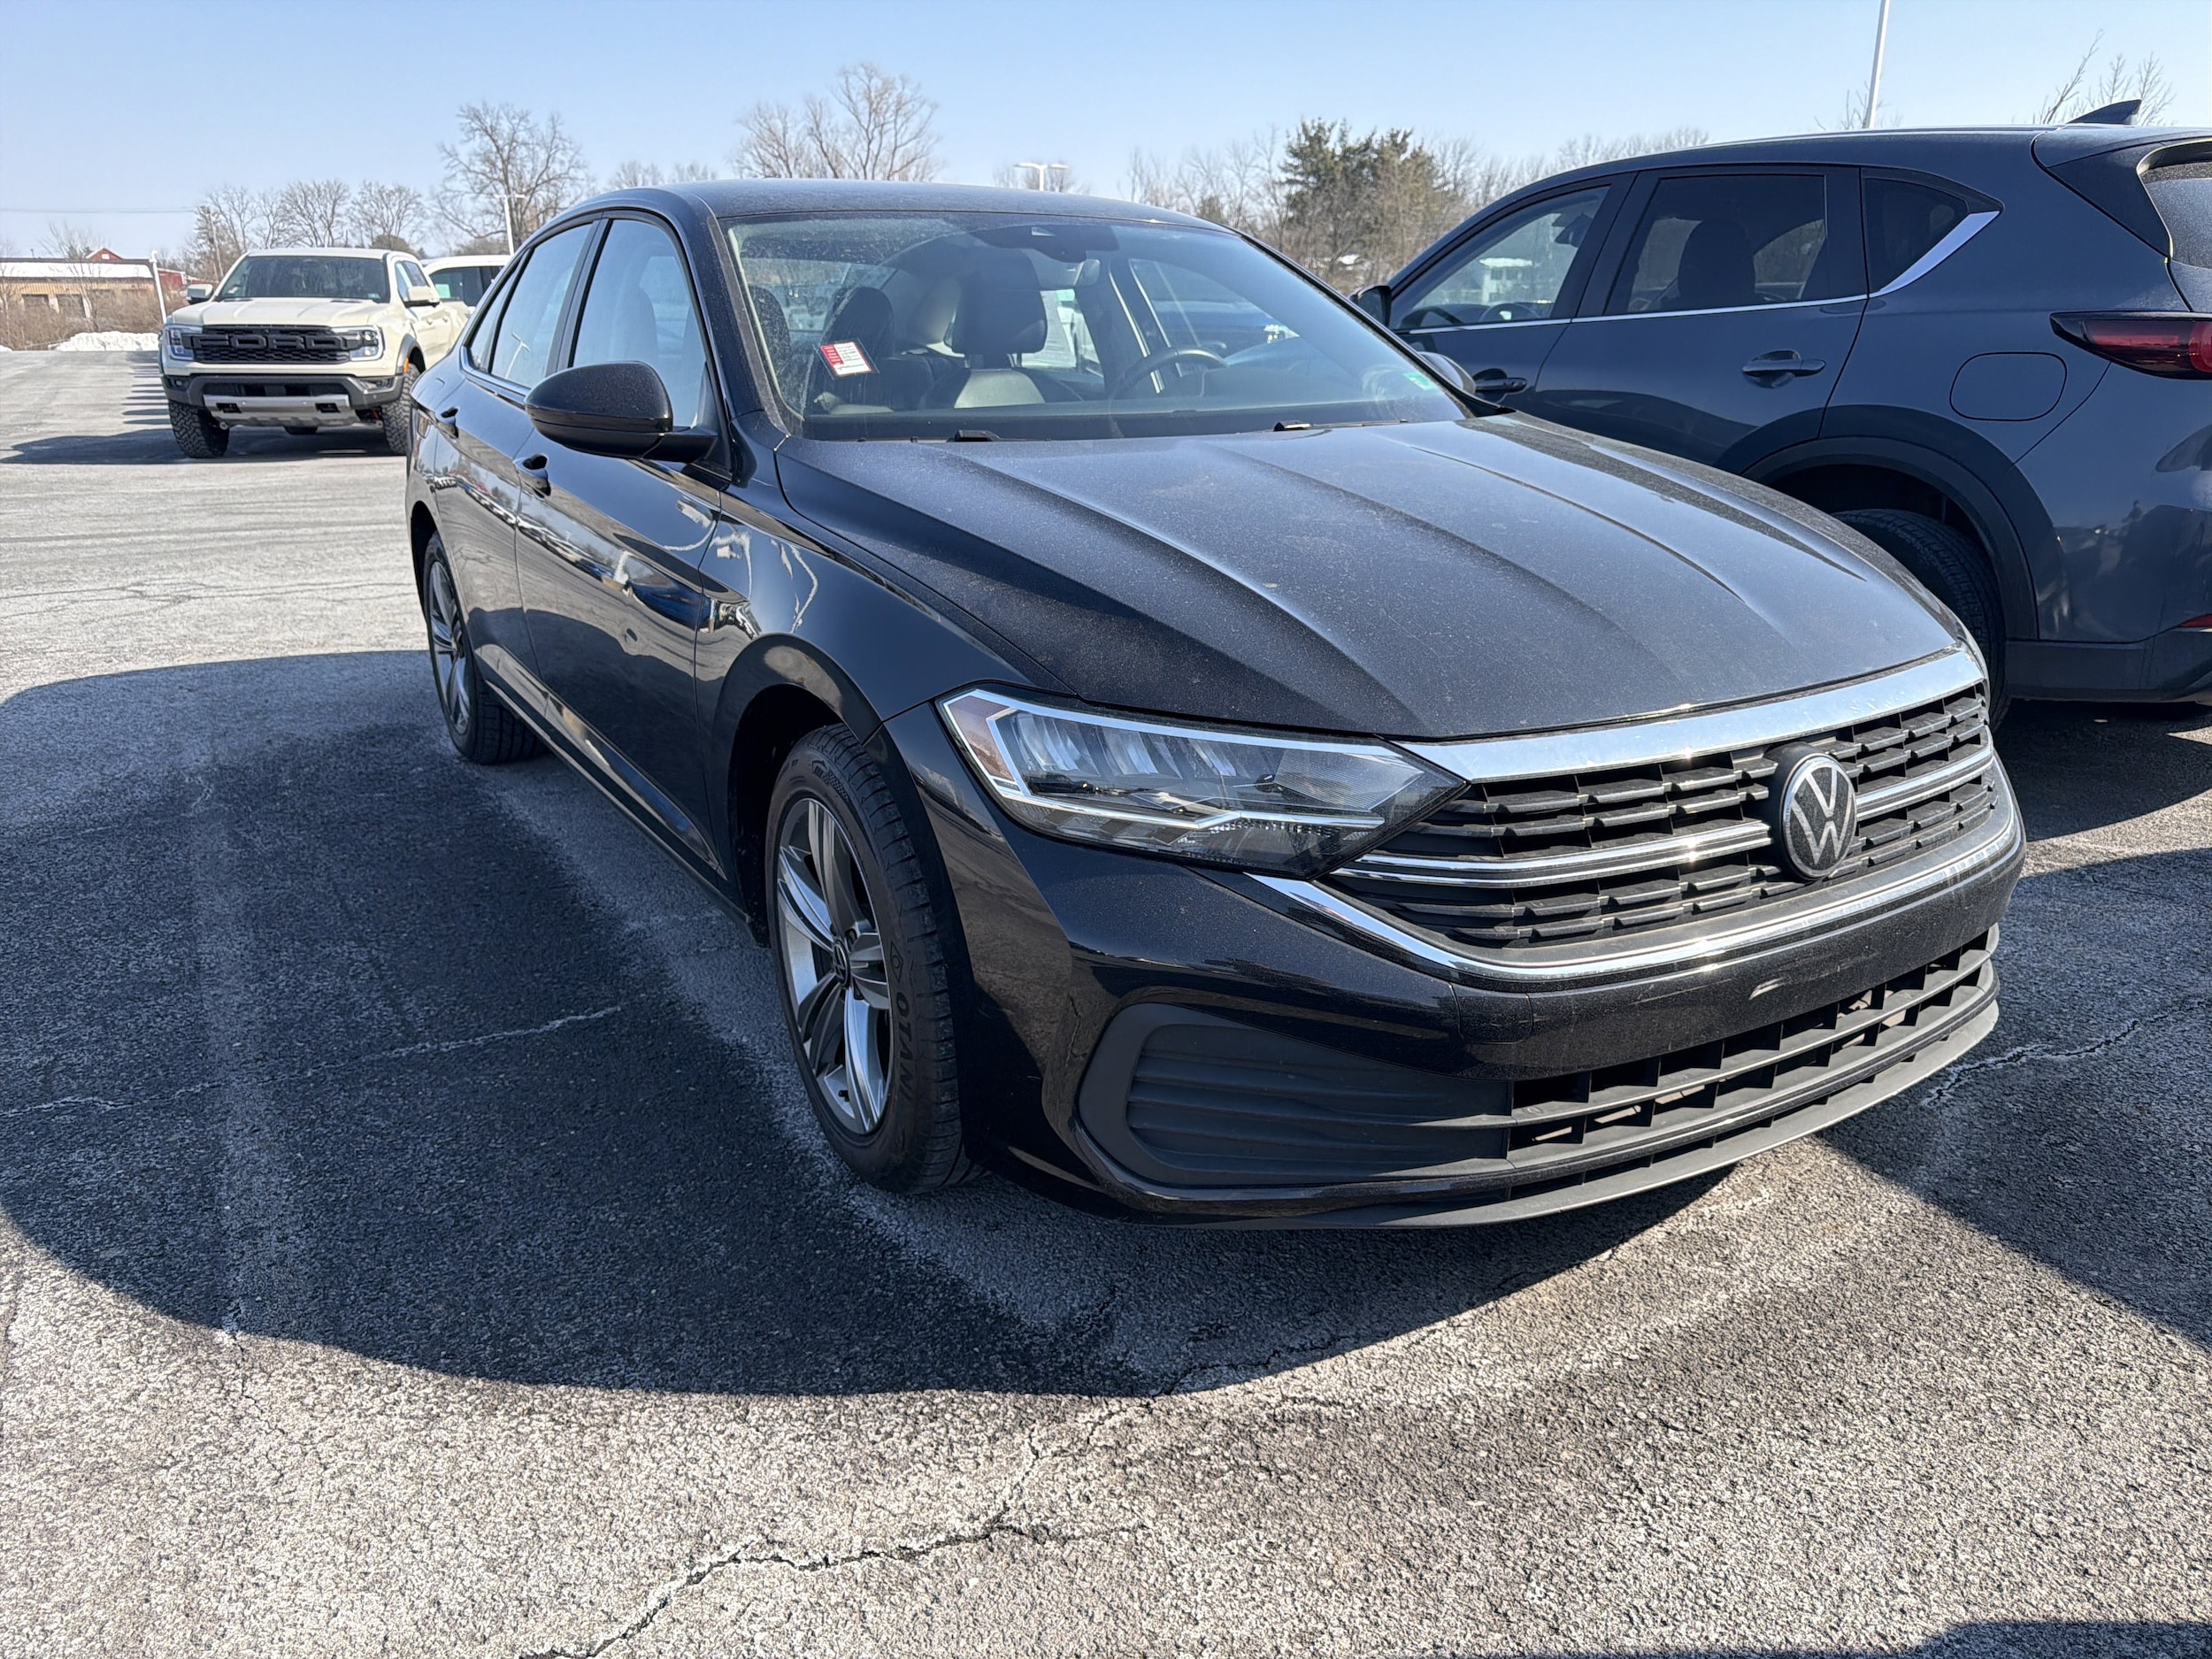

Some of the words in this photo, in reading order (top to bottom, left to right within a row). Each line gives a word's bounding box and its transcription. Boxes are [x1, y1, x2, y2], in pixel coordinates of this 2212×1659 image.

[192, 334, 349, 350] FORD
[1786, 761, 1855, 872] VW
[896, 992, 913, 1101] OTANI
